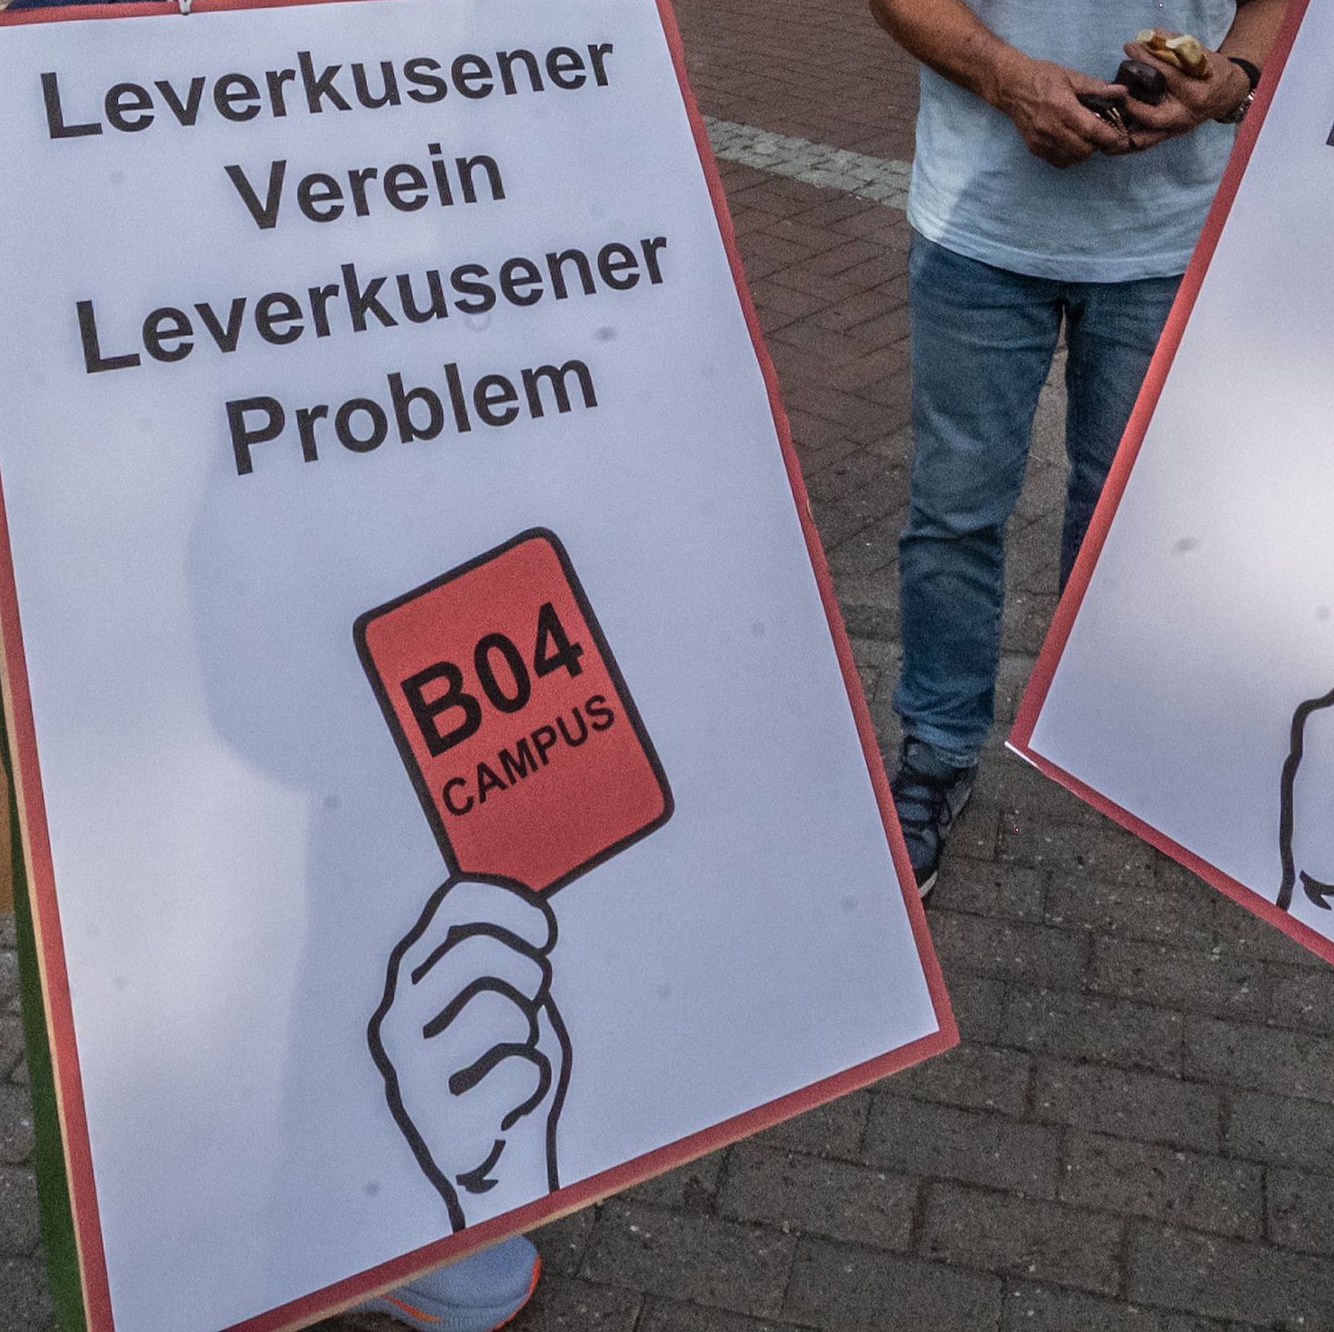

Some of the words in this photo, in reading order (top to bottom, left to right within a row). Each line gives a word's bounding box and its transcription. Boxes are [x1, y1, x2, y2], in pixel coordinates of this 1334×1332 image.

[41, 36, 613, 139] Leverkusener
[225, 142, 505, 230] Verein
[76, 234, 667, 374] Leverkusener
[226, 357, 598, 476] Problem
[401, 601, 585, 758] B04
[441, 693, 616, 819] CAMPUS
